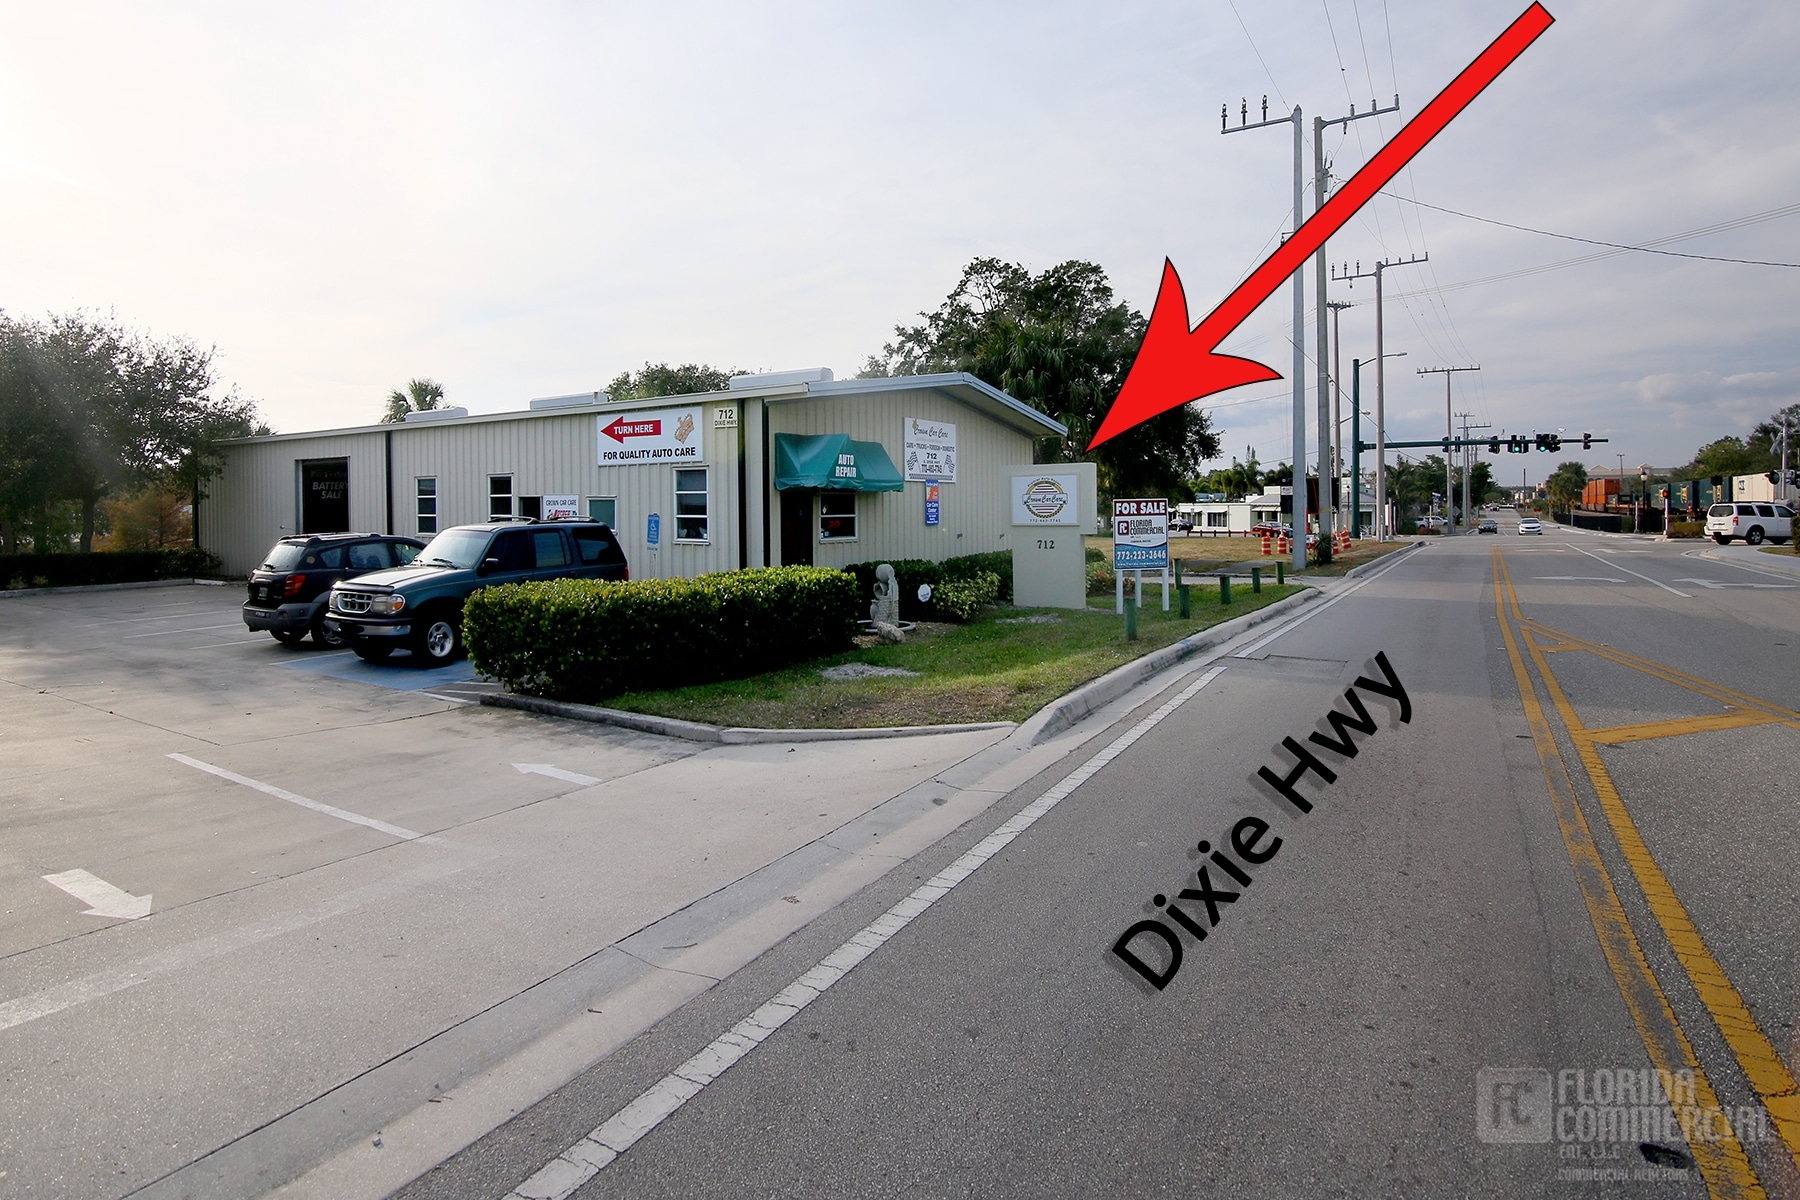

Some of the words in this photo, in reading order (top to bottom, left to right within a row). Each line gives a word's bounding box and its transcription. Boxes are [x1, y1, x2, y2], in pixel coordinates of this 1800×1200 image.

[718, 409, 734, 420] 712
[613, 425, 633, 435] TURN
[634, 423, 654, 433] HERE
[603, 451, 618, 461] FOR
[619, 449, 651, 460] QUALITY
[651, 448, 673, 459] AUTO
[674, 446, 696, 457] CARE
[926, 452, 938, 460] 712
[837, 454, 855, 466] AUTO
[835, 466, 857, 478] REPAIR
[321, 490, 343, 499] SALE
[1026, 495, 1042, 504] Crown
[1042, 494, 1052, 503] Car
[1052, 494, 1064, 503] Care
[1115, 502, 1138, 515] FOR
[1140, 501, 1166, 514] SALE
[1130, 519, 1153, 528] FLORIDA
[1130, 526, 1165, 535] COMMERCIAL
[1036, 539, 1055, 550] 712
